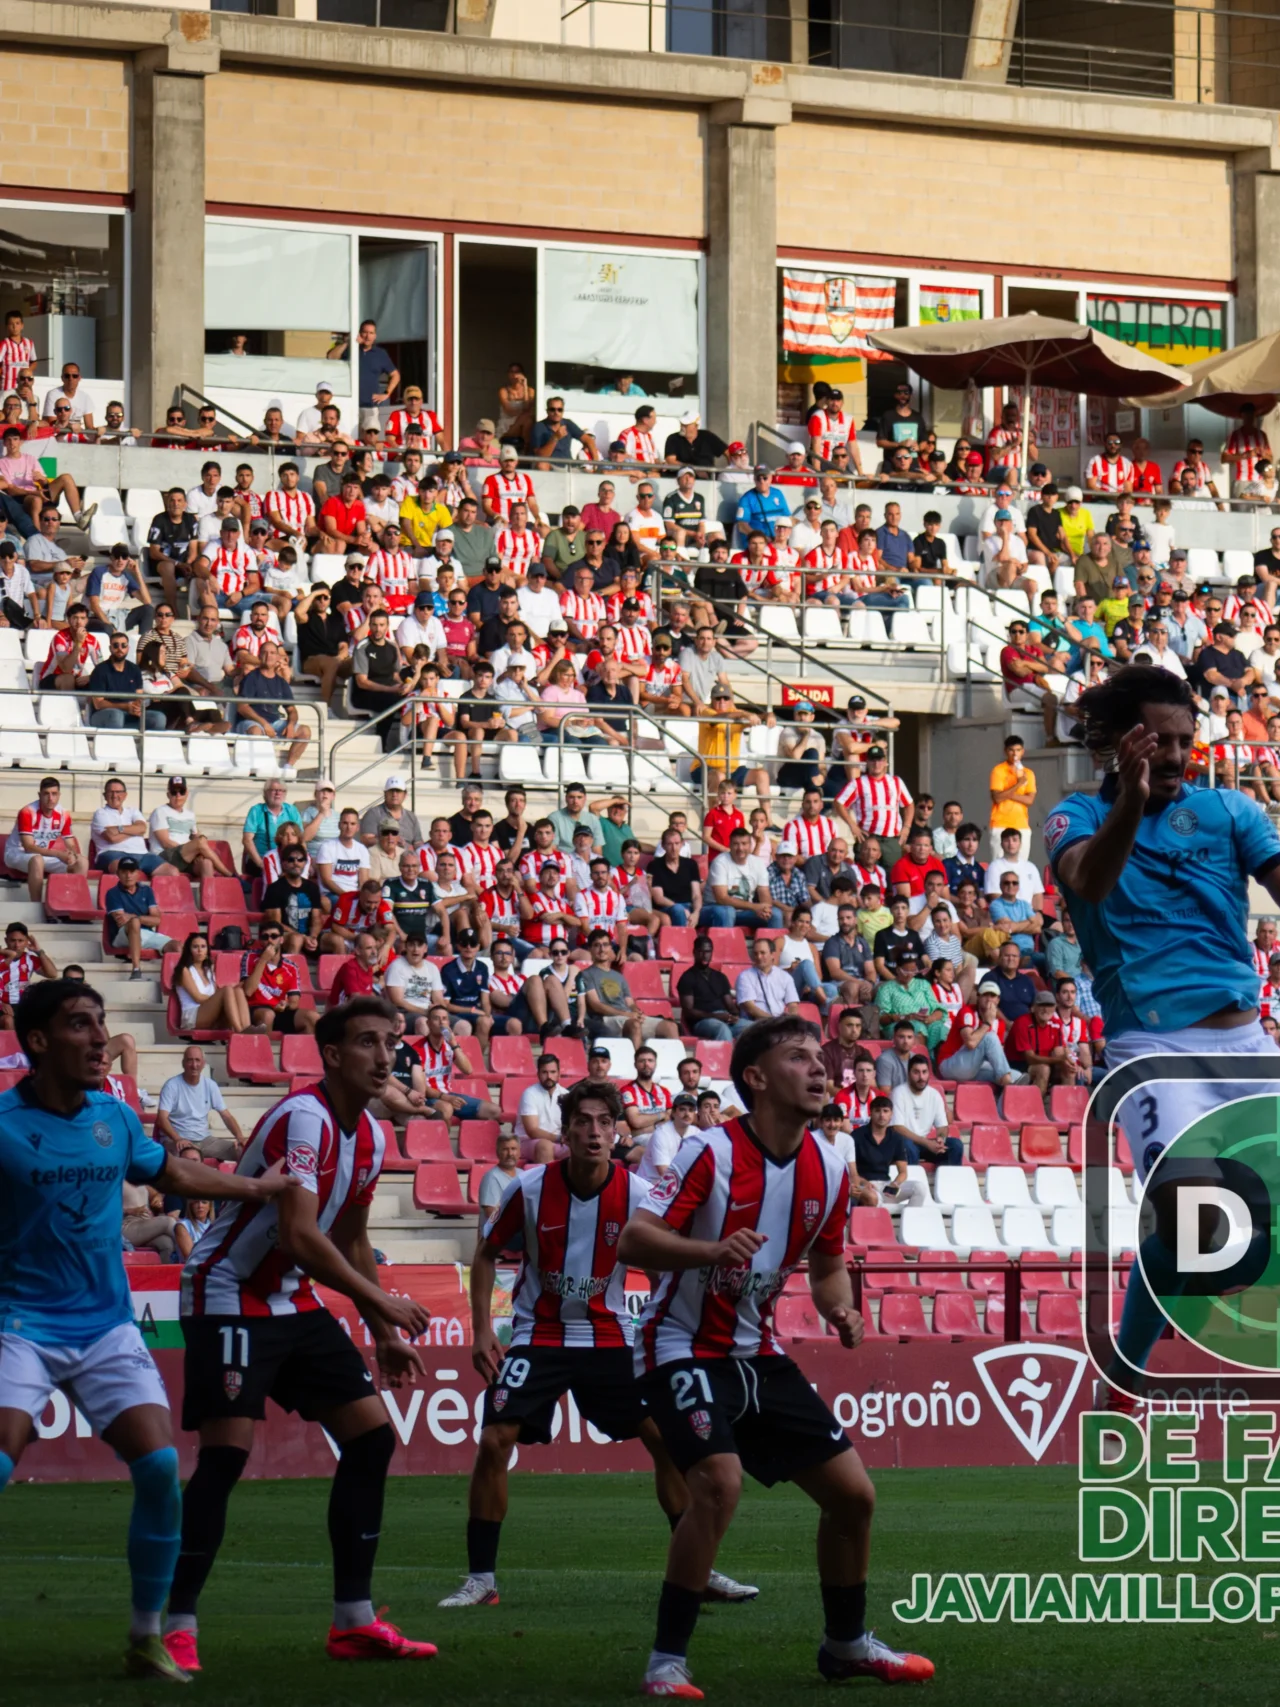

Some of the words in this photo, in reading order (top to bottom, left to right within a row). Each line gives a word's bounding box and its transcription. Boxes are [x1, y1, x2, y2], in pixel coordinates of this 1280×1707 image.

[1141, 1095, 1159, 1139] 3
[219, 1326, 249, 1367] 11
[499, 1356, 530, 1388] 19
[670, 1368, 714, 1410] 21
[811, 1381, 981, 1438] ogroño
